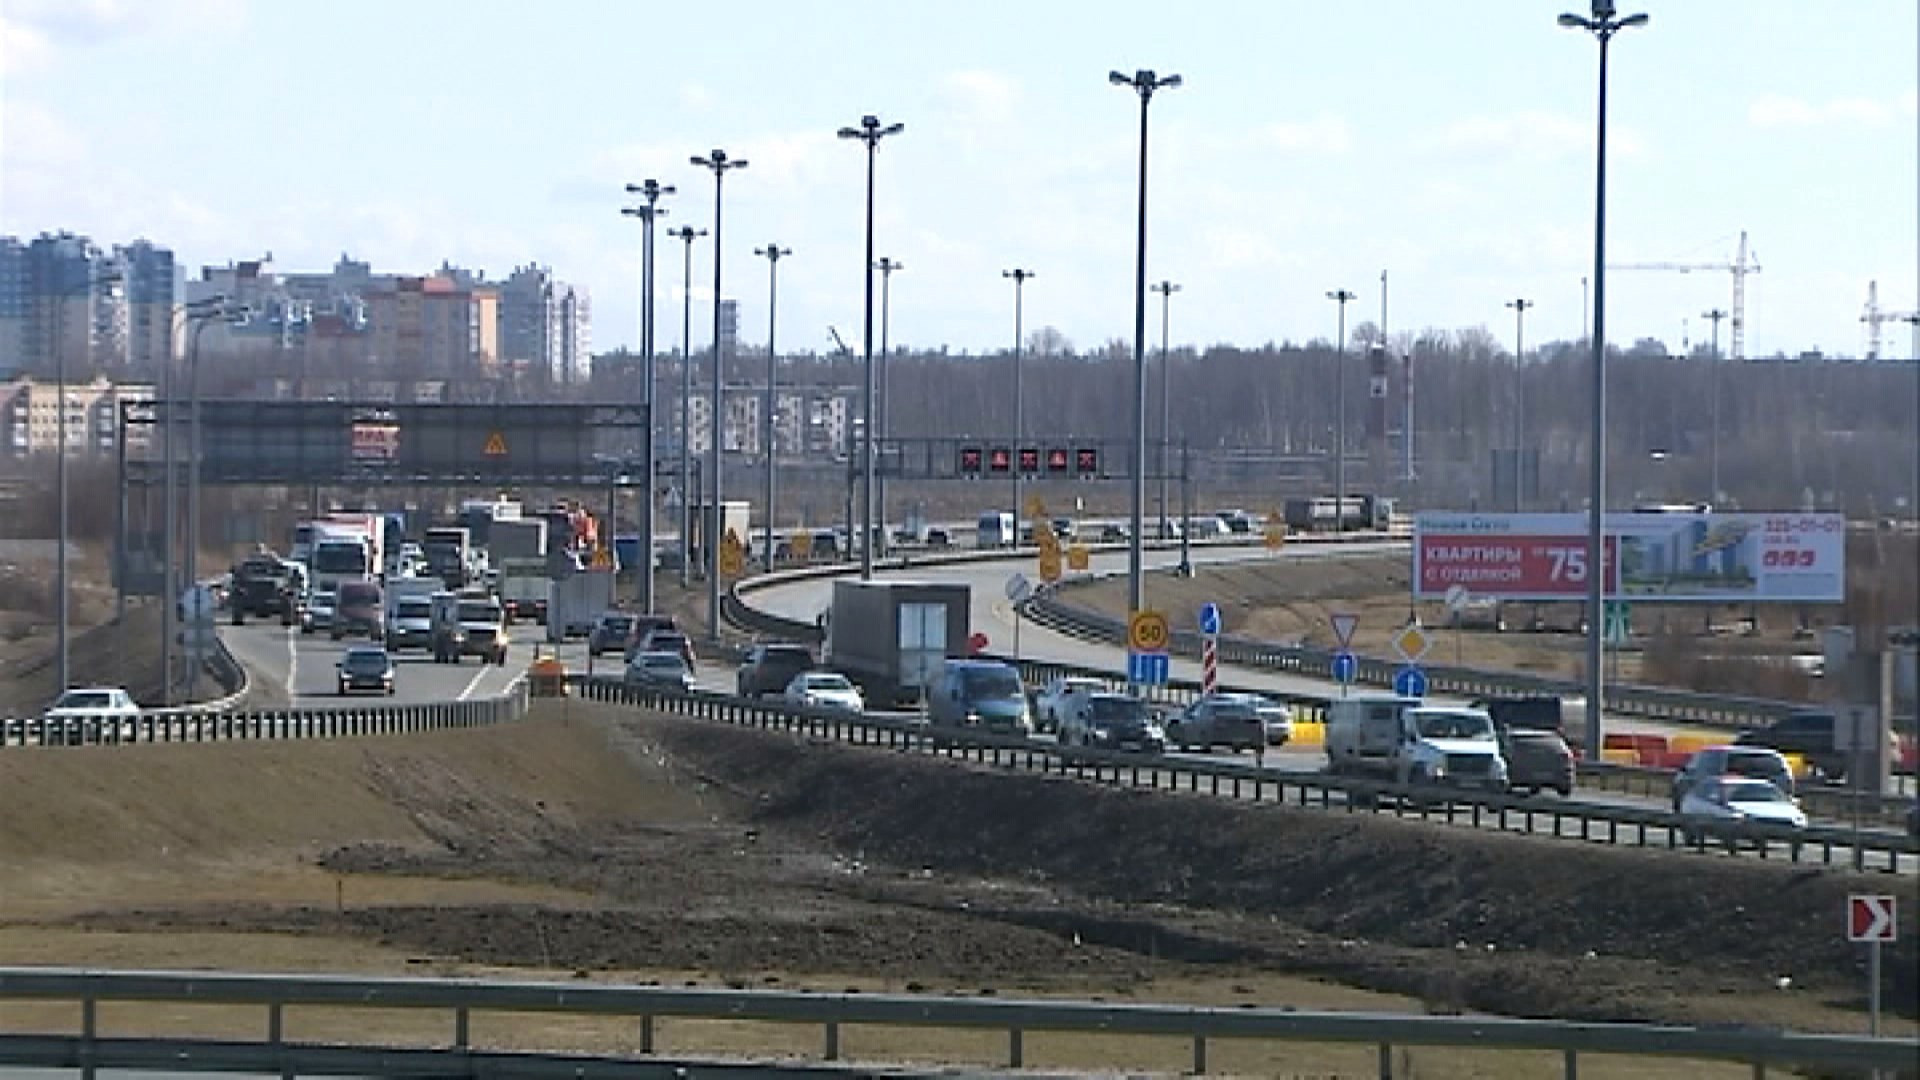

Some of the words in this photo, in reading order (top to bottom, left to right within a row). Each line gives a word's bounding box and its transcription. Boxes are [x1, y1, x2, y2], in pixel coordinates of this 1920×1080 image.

[1425, 547, 1522, 562] КВАРТИРЫ
[1546, 547, 1588, 582] 75
[1439, 566, 1522, 584] ОТДЕЛКОЙ
